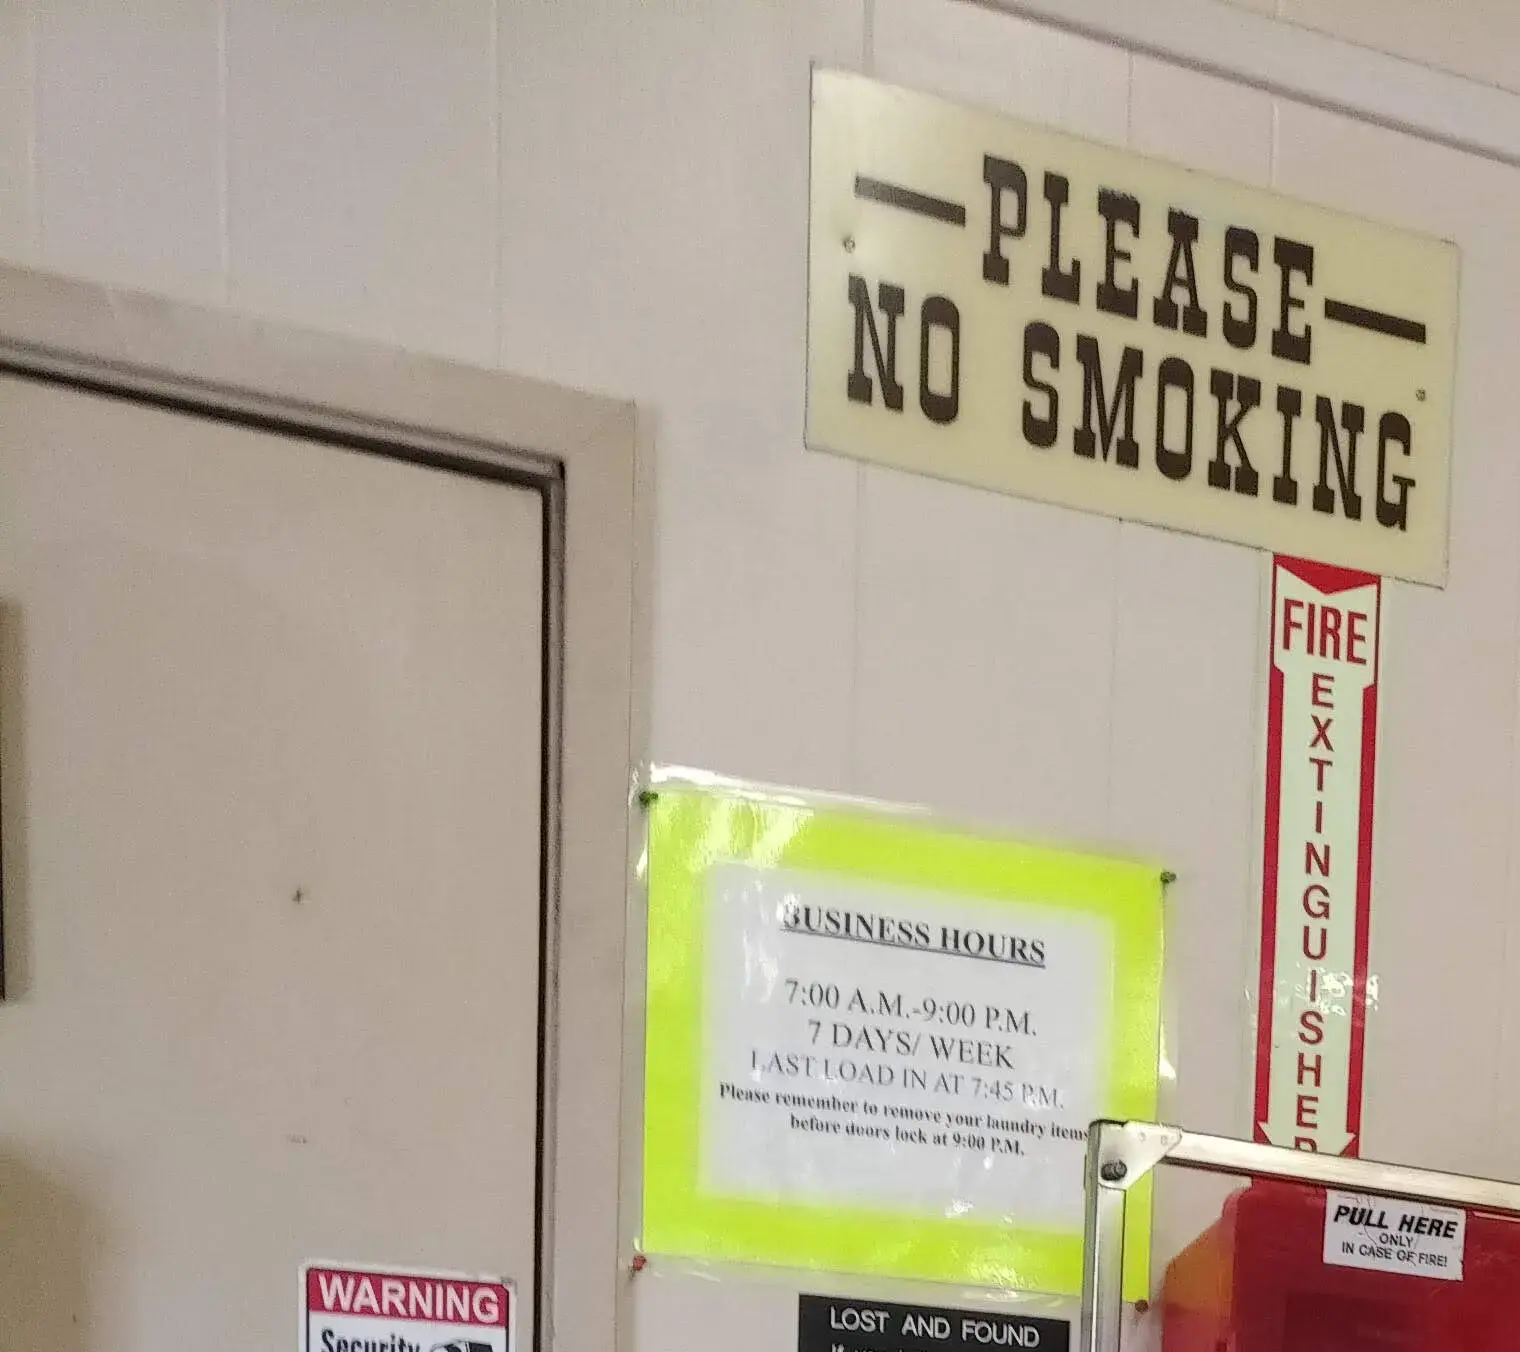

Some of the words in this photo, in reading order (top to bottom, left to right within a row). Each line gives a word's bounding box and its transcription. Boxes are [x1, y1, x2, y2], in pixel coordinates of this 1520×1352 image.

[982, 154, 1313, 365] PLEASE
[847, 273, 960, 425] NO
[1022, 320, 1416, 531] SMOKING
[1283, 597, 1368, 665] FIRE
[783, 904, 931, 949] BUSINESS
[941, 926, 1046, 964] HOURS
[785, 978, 840, 1009] 7:00
[985, 1005, 1037, 1036] P.M.
[808, 1019, 821, 1045] 7
[930, 1033, 1014, 1070] WEEK
[752, 1050, 817, 1077] LAST
[824, 1057, 894, 1086] LOAD
[903, 1068, 927, 1090] IN
[934, 1072, 965, 1095] AT
[971, 1077, 1014, 1102] 7:45
[719, 1082, 771, 1103] Please
[775, 1092, 858, 1113] remember
[863, 1100, 878, 1116] to
[883, 1104, 941, 1123] remove
[946, 1112, 983, 1129] your
[986, 1114, 1045, 1139] laundry
[790, 1114, 841, 1134] before
[845, 1121, 890, 1140] doors
[895, 1125, 927, 1144] lock
[932, 1132, 947, 1146] at
[1333, 1205, 1389, 1230] PULL
[1398, 1213, 1459, 1239] HERE
[1379, 1232, 1413, 1249] ONLY
[1341, 1241, 1354, 1255] IN
[1359, 1243, 1393, 1260] CASE
[1396, 1249, 1416, 1263] OF
[1418, 1251, 1448, 1268] FIRE!
[318, 1273, 500, 1324] WARNING
[830, 1306, 891, 1334] LOST
[901, 1313, 950, 1340] AND
[962, 1319, 1040, 1348] FOUND
